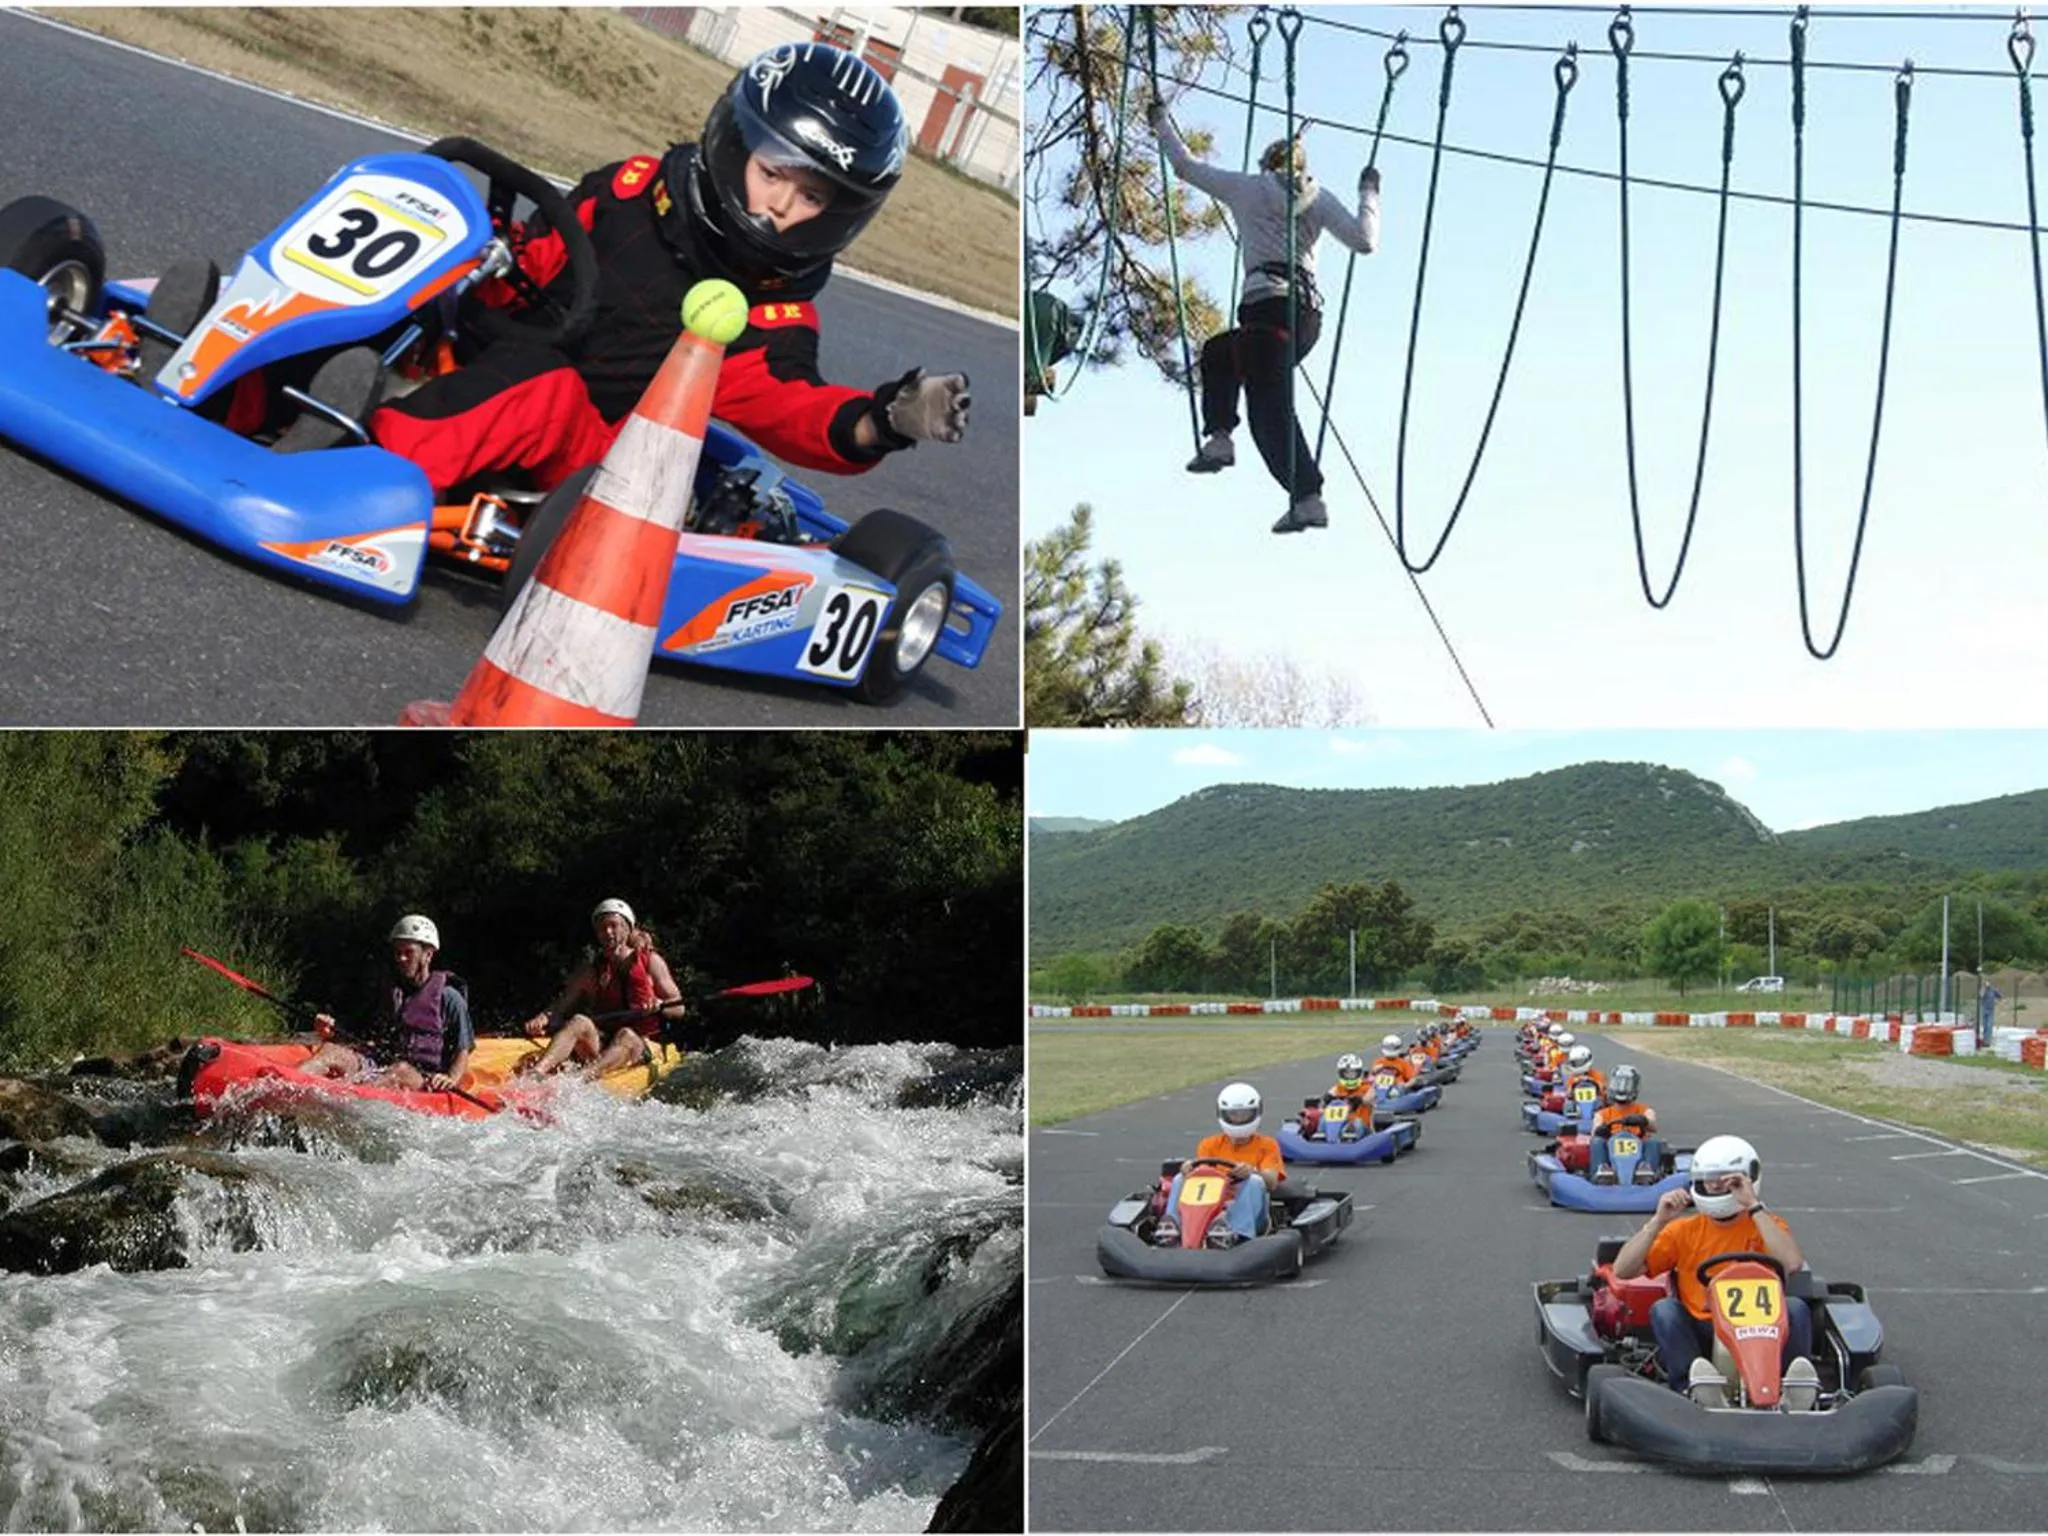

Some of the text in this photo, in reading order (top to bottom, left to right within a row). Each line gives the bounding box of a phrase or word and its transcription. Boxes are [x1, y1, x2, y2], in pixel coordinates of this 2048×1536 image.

[307, 208, 421, 279] 30
[726, 589, 794, 625] FFSA
[808, 592, 877, 672] 30
[1197, 1183, 1207, 1202] 1
[1727, 1285, 1773, 1317] 24
